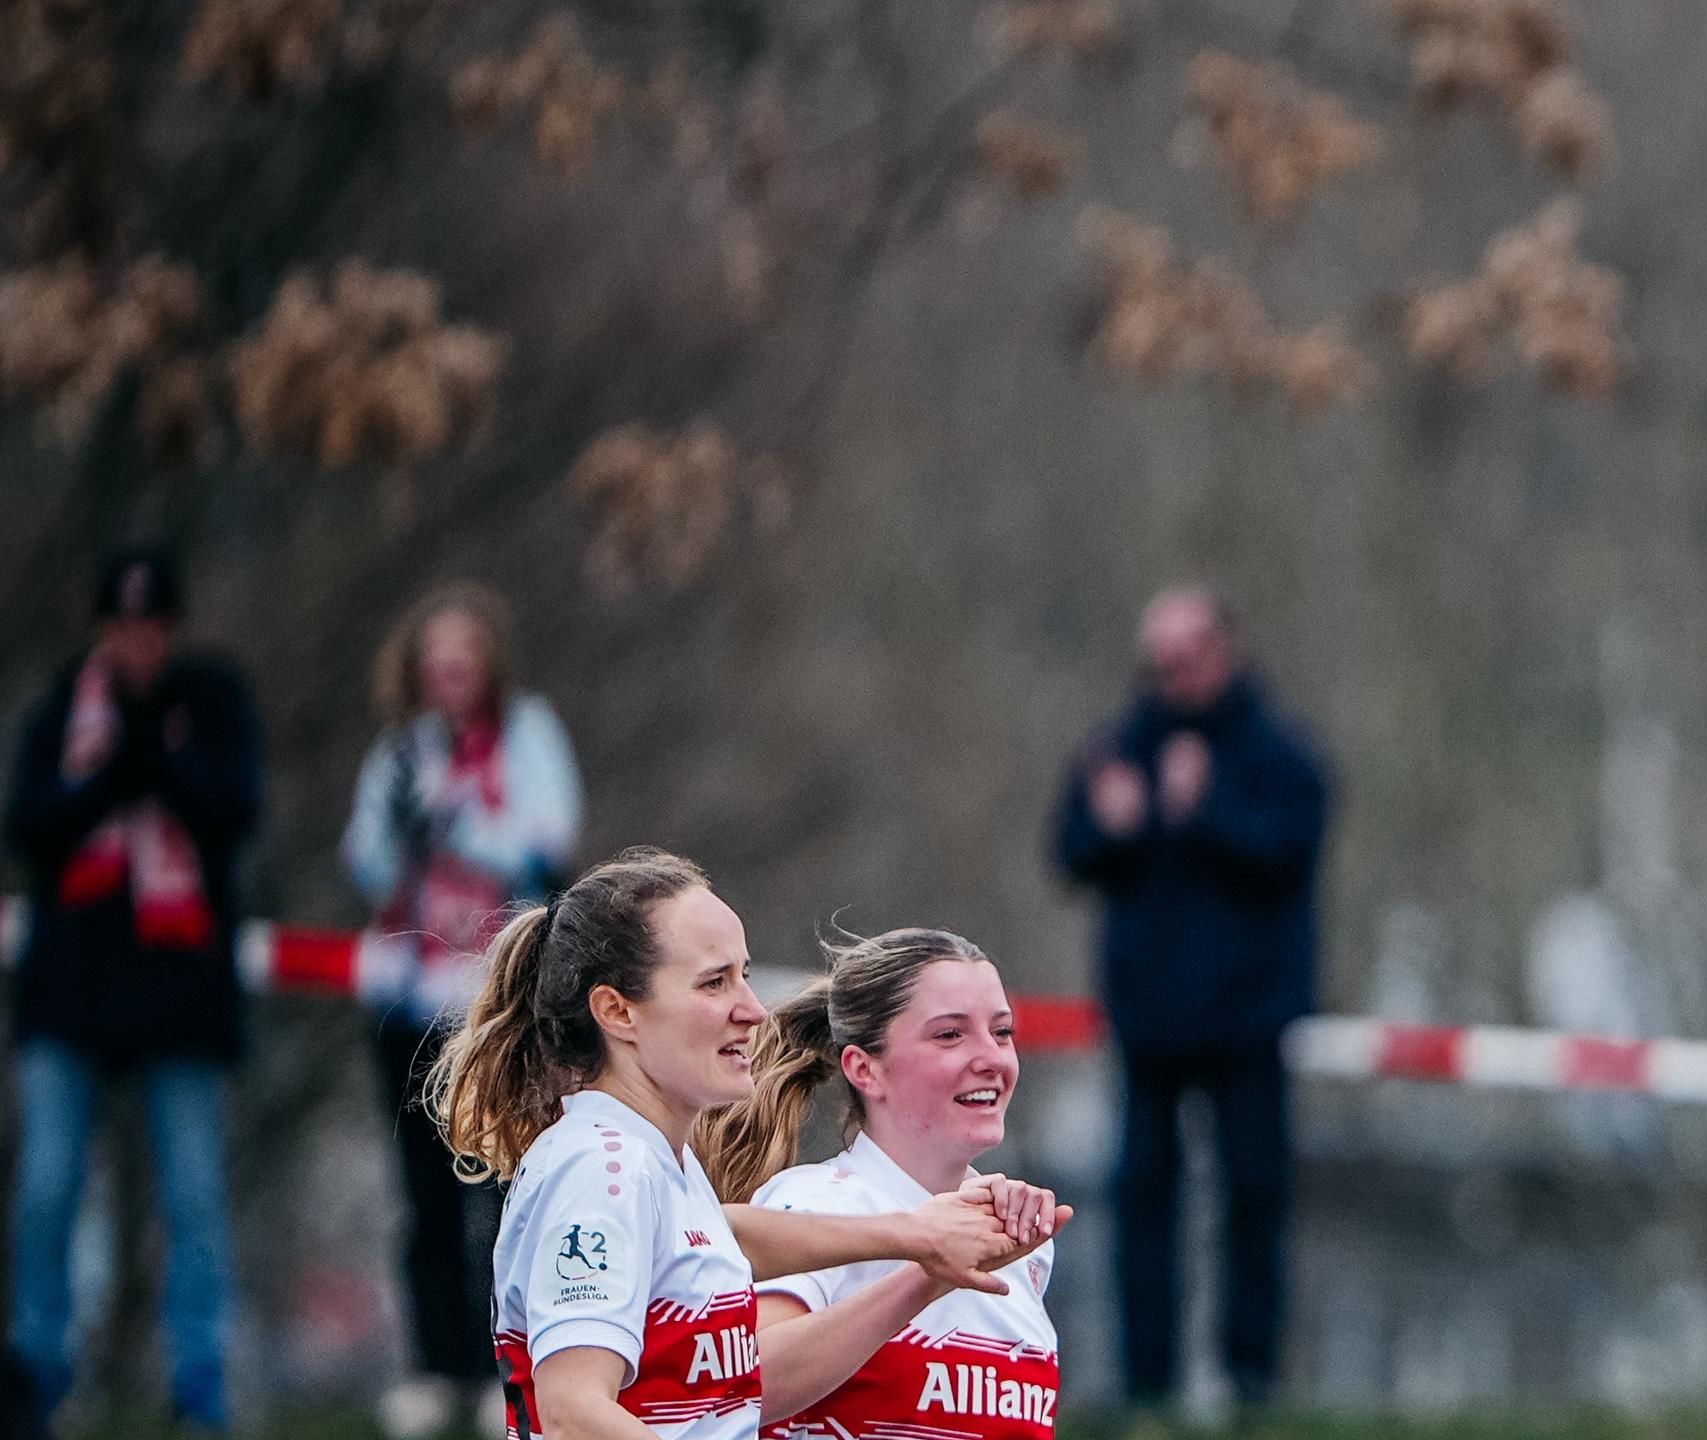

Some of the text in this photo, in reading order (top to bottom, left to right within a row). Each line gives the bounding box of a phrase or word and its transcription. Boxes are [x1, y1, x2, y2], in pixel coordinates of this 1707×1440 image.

[590, 1231, 607, 1254] 2
[685, 1324, 760, 1385] Alli
[916, 1361, 1057, 1428] Allianz
